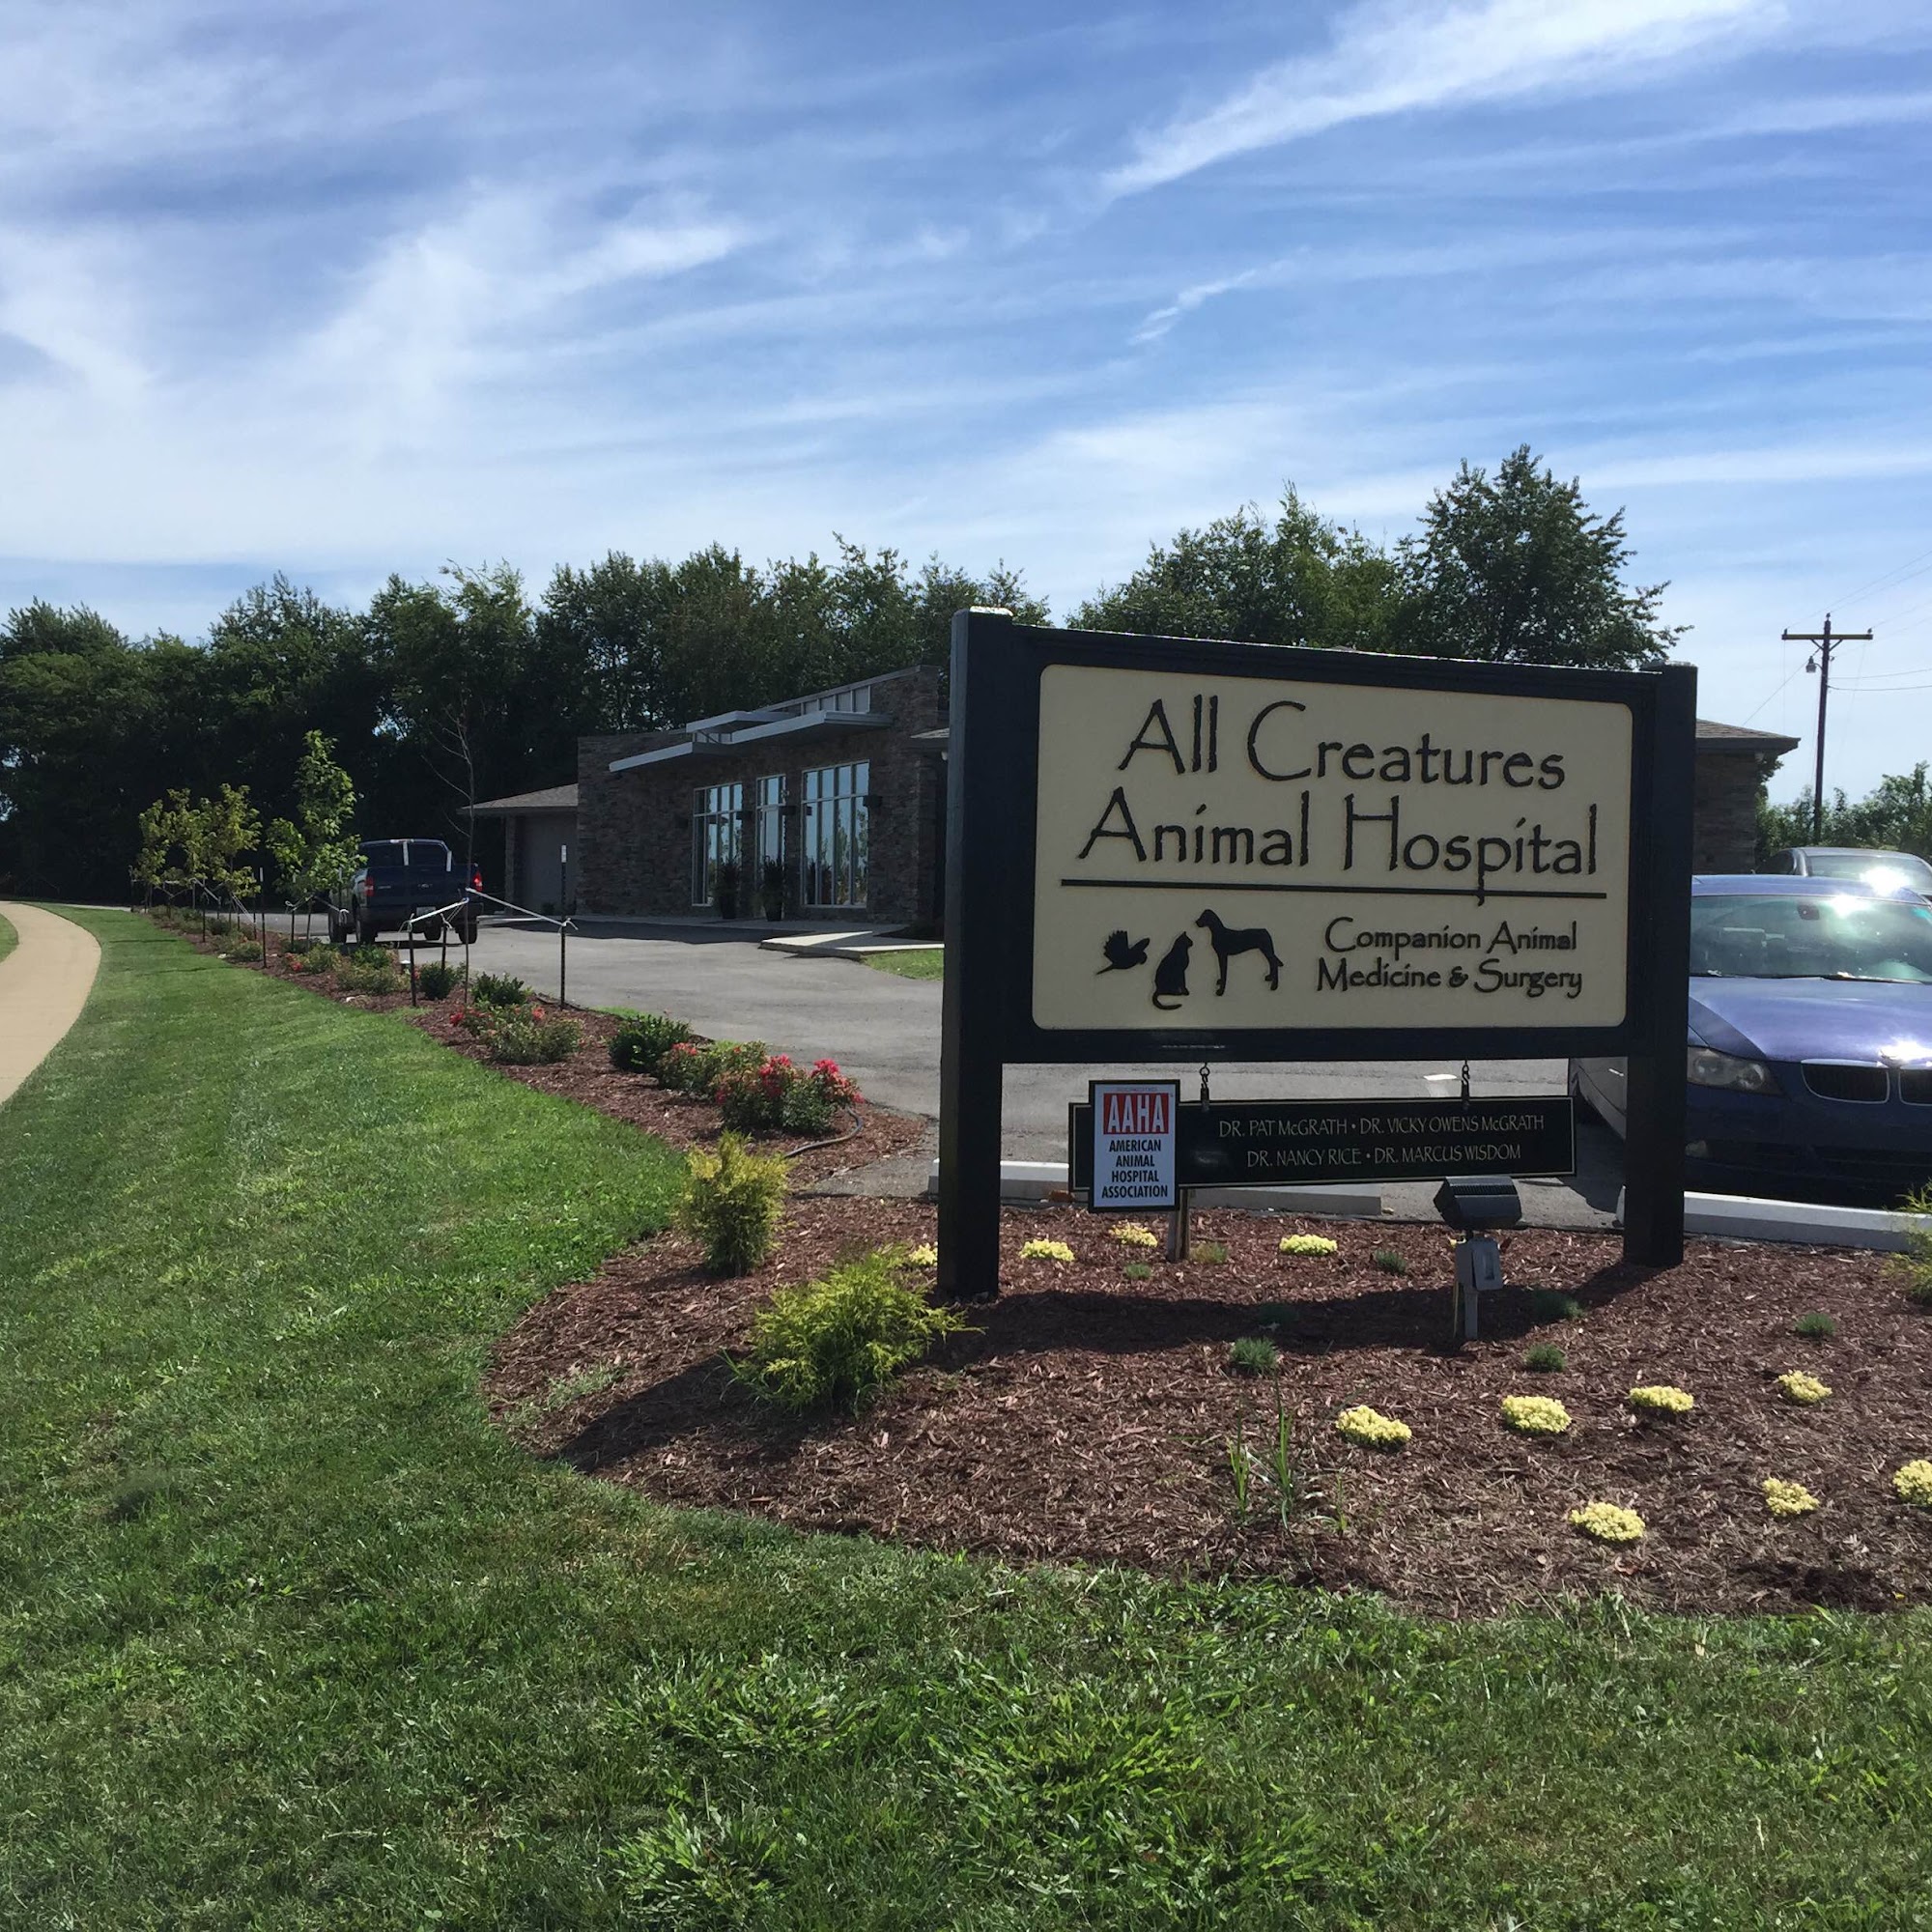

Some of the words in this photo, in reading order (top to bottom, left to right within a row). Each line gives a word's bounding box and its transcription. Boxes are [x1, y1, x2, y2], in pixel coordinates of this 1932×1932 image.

[1118, 695, 1218, 776] All
[1247, 700, 1565, 790] Creatures
[1078, 786, 1309, 867] Animal
[1344, 792, 1597, 906] Hospital
[1324, 917, 1480, 960] Companion
[1487, 921, 1577, 954] Animal
[1317, 957, 1441, 991] Medicine
[1448, 966, 1468, 988] &
[1473, 958, 1582, 999] Surgery
[1106, 1094, 1165, 1133] AAHA
[1219, 1120, 1245, 1137] DR.
[1249, 1119, 1275, 1136] PAT
[1278, 1118, 1348, 1136] McGRATH
[1360, 1117, 1384, 1134] DR.
[1387, 1117, 1428, 1133] VICKY
[1429, 1116, 1479, 1132] OWENS
[1481, 1114, 1545, 1131] McGRATH
[1109, 1139, 1161, 1152] AMERICAN
[1247, 1150, 1273, 1167] DR.
[1276, 1148, 1325, 1166] NANCY
[1328, 1148, 1361, 1165] RICE
[1374, 1147, 1399, 1164] DR.
[1402, 1145, 1463, 1162] MARCUS
[1464, 1144, 1521, 1160] WISDOM
[1116, 1154, 1155, 1167] ANIMAL
[1112, 1170, 1159, 1182] HOSPITAL
[1101, 1184, 1168, 1199] ASSOCIATION
